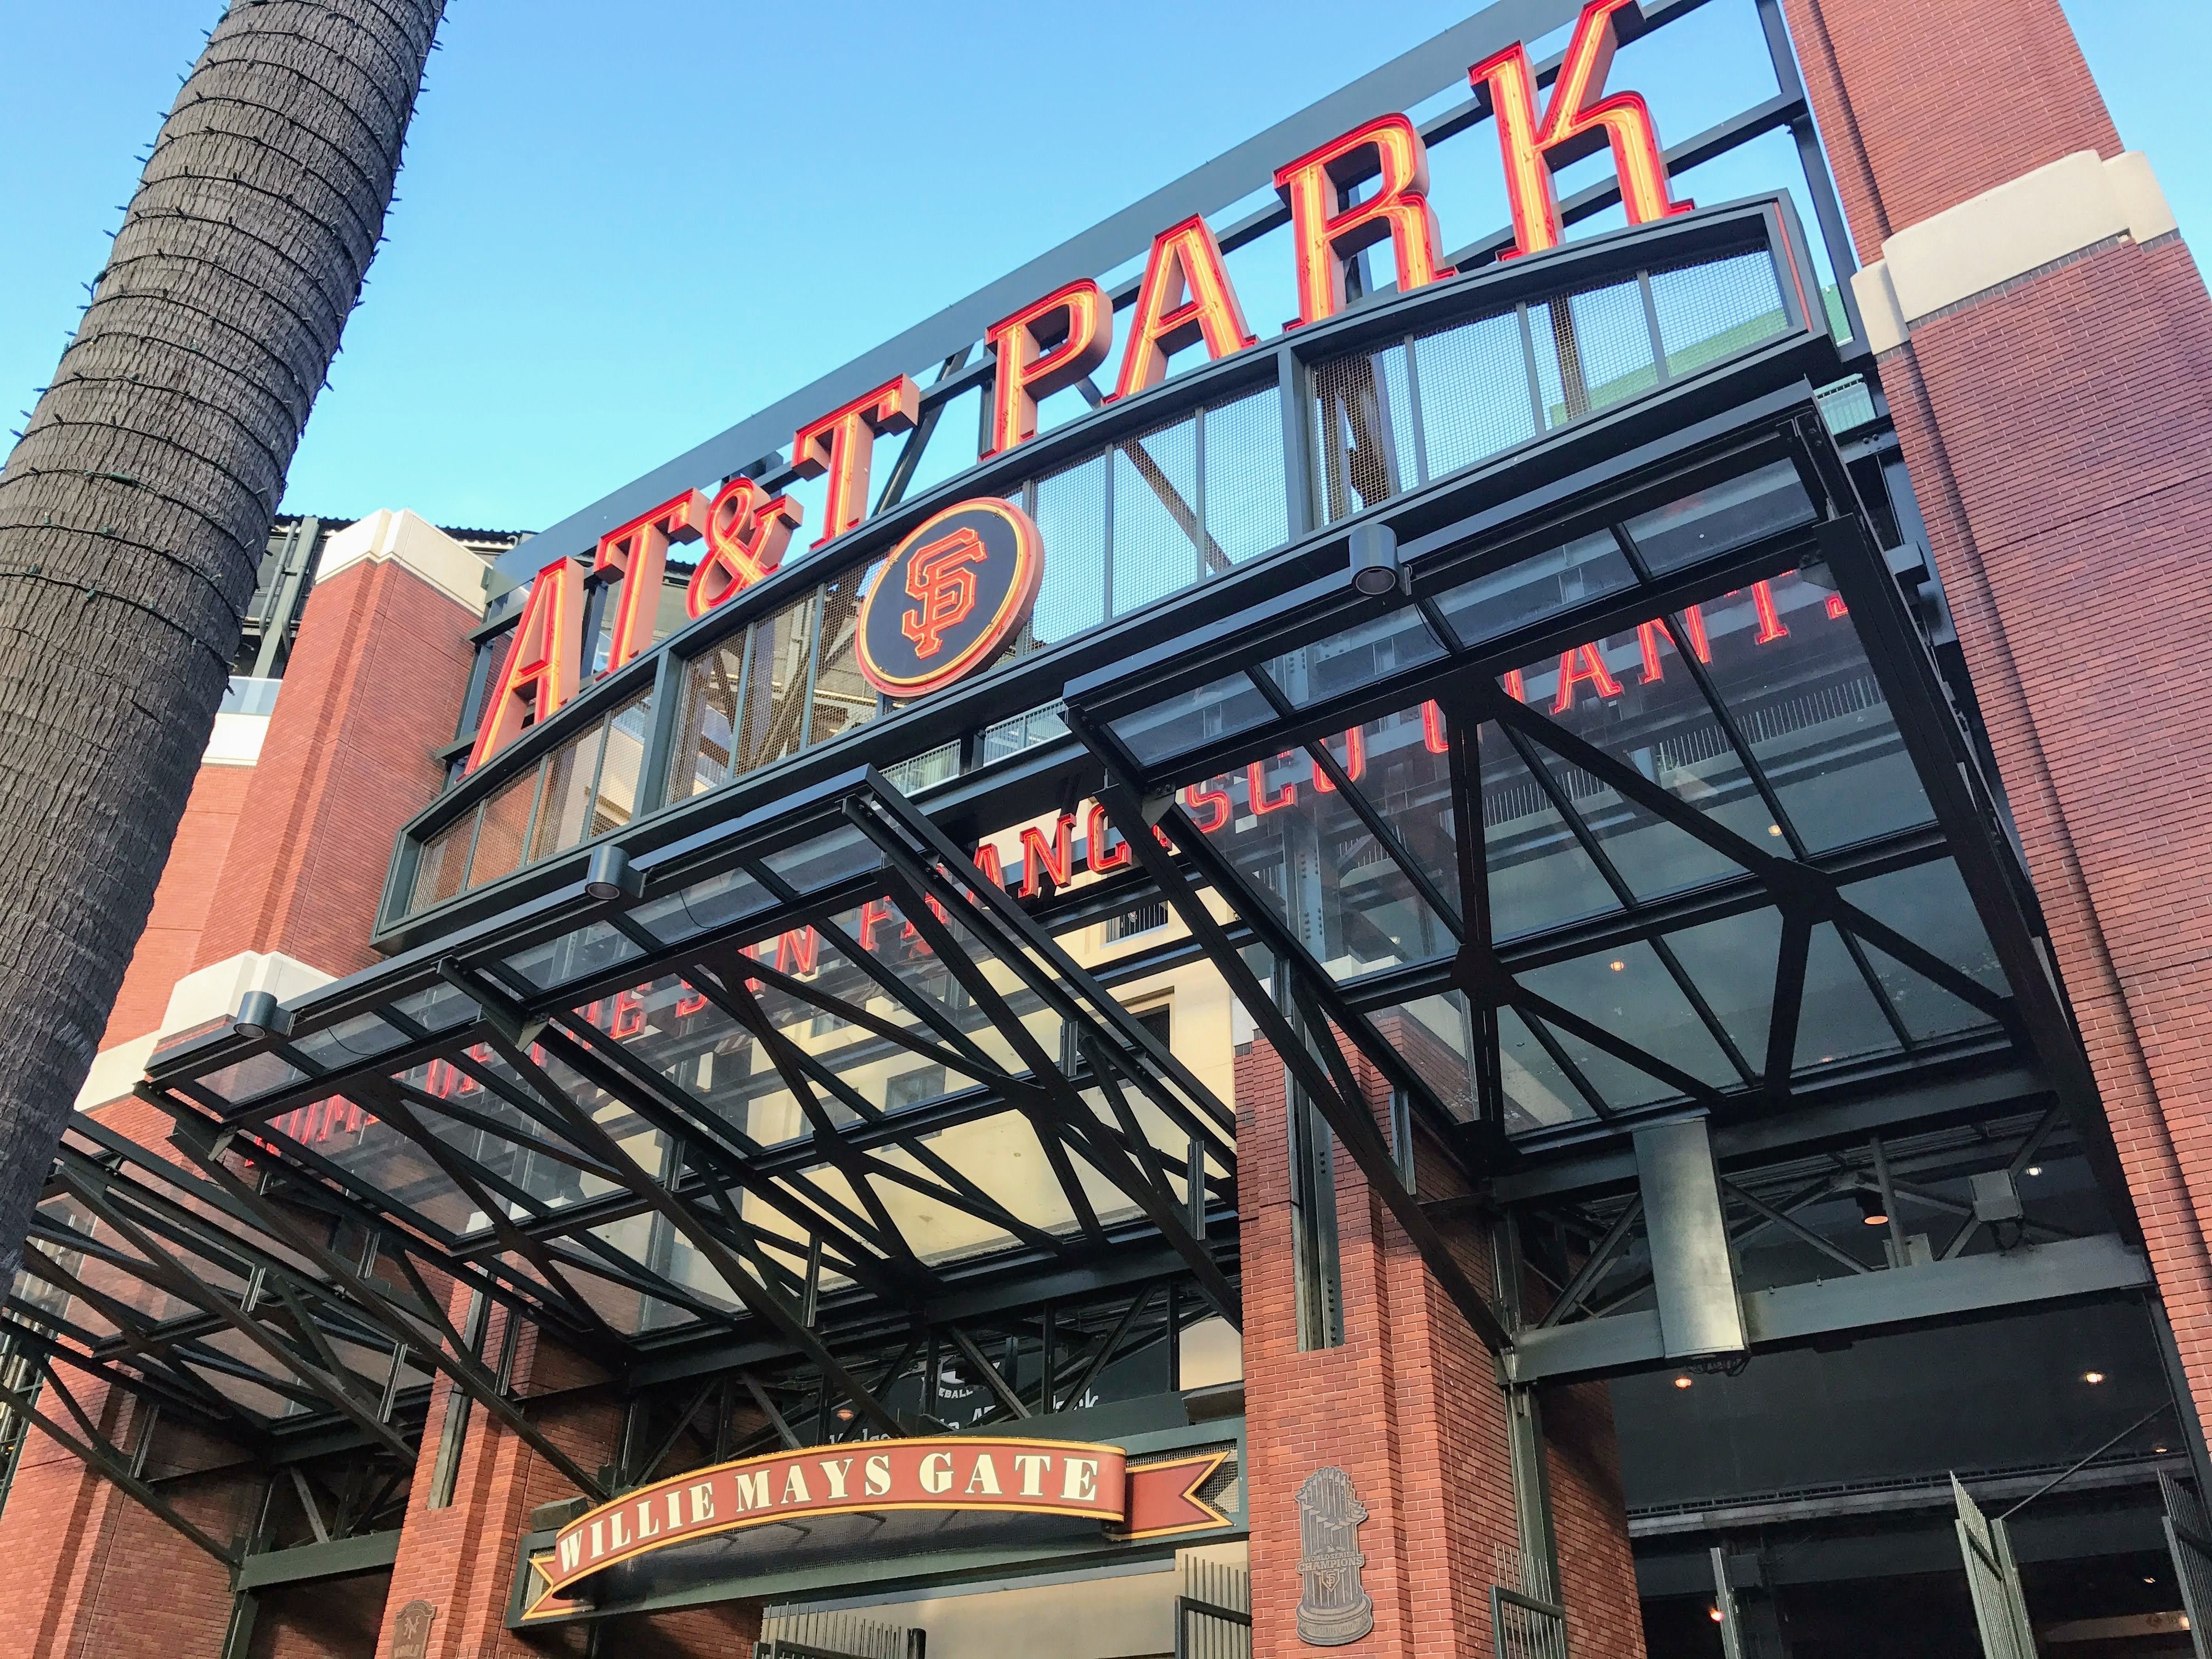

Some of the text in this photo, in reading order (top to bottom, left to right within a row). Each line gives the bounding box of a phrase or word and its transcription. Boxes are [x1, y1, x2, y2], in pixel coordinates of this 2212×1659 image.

[455, 0, 1695, 782] AT&T PARK
[859, 725, 1366, 952] FANCSCO
[560, 1452, 1098, 1573] WILLIE MAYS GATE
[1297, 1555, 1362, 1572] CHAMPIONS
[1304, 1553, 1330, 1562] WORLD
